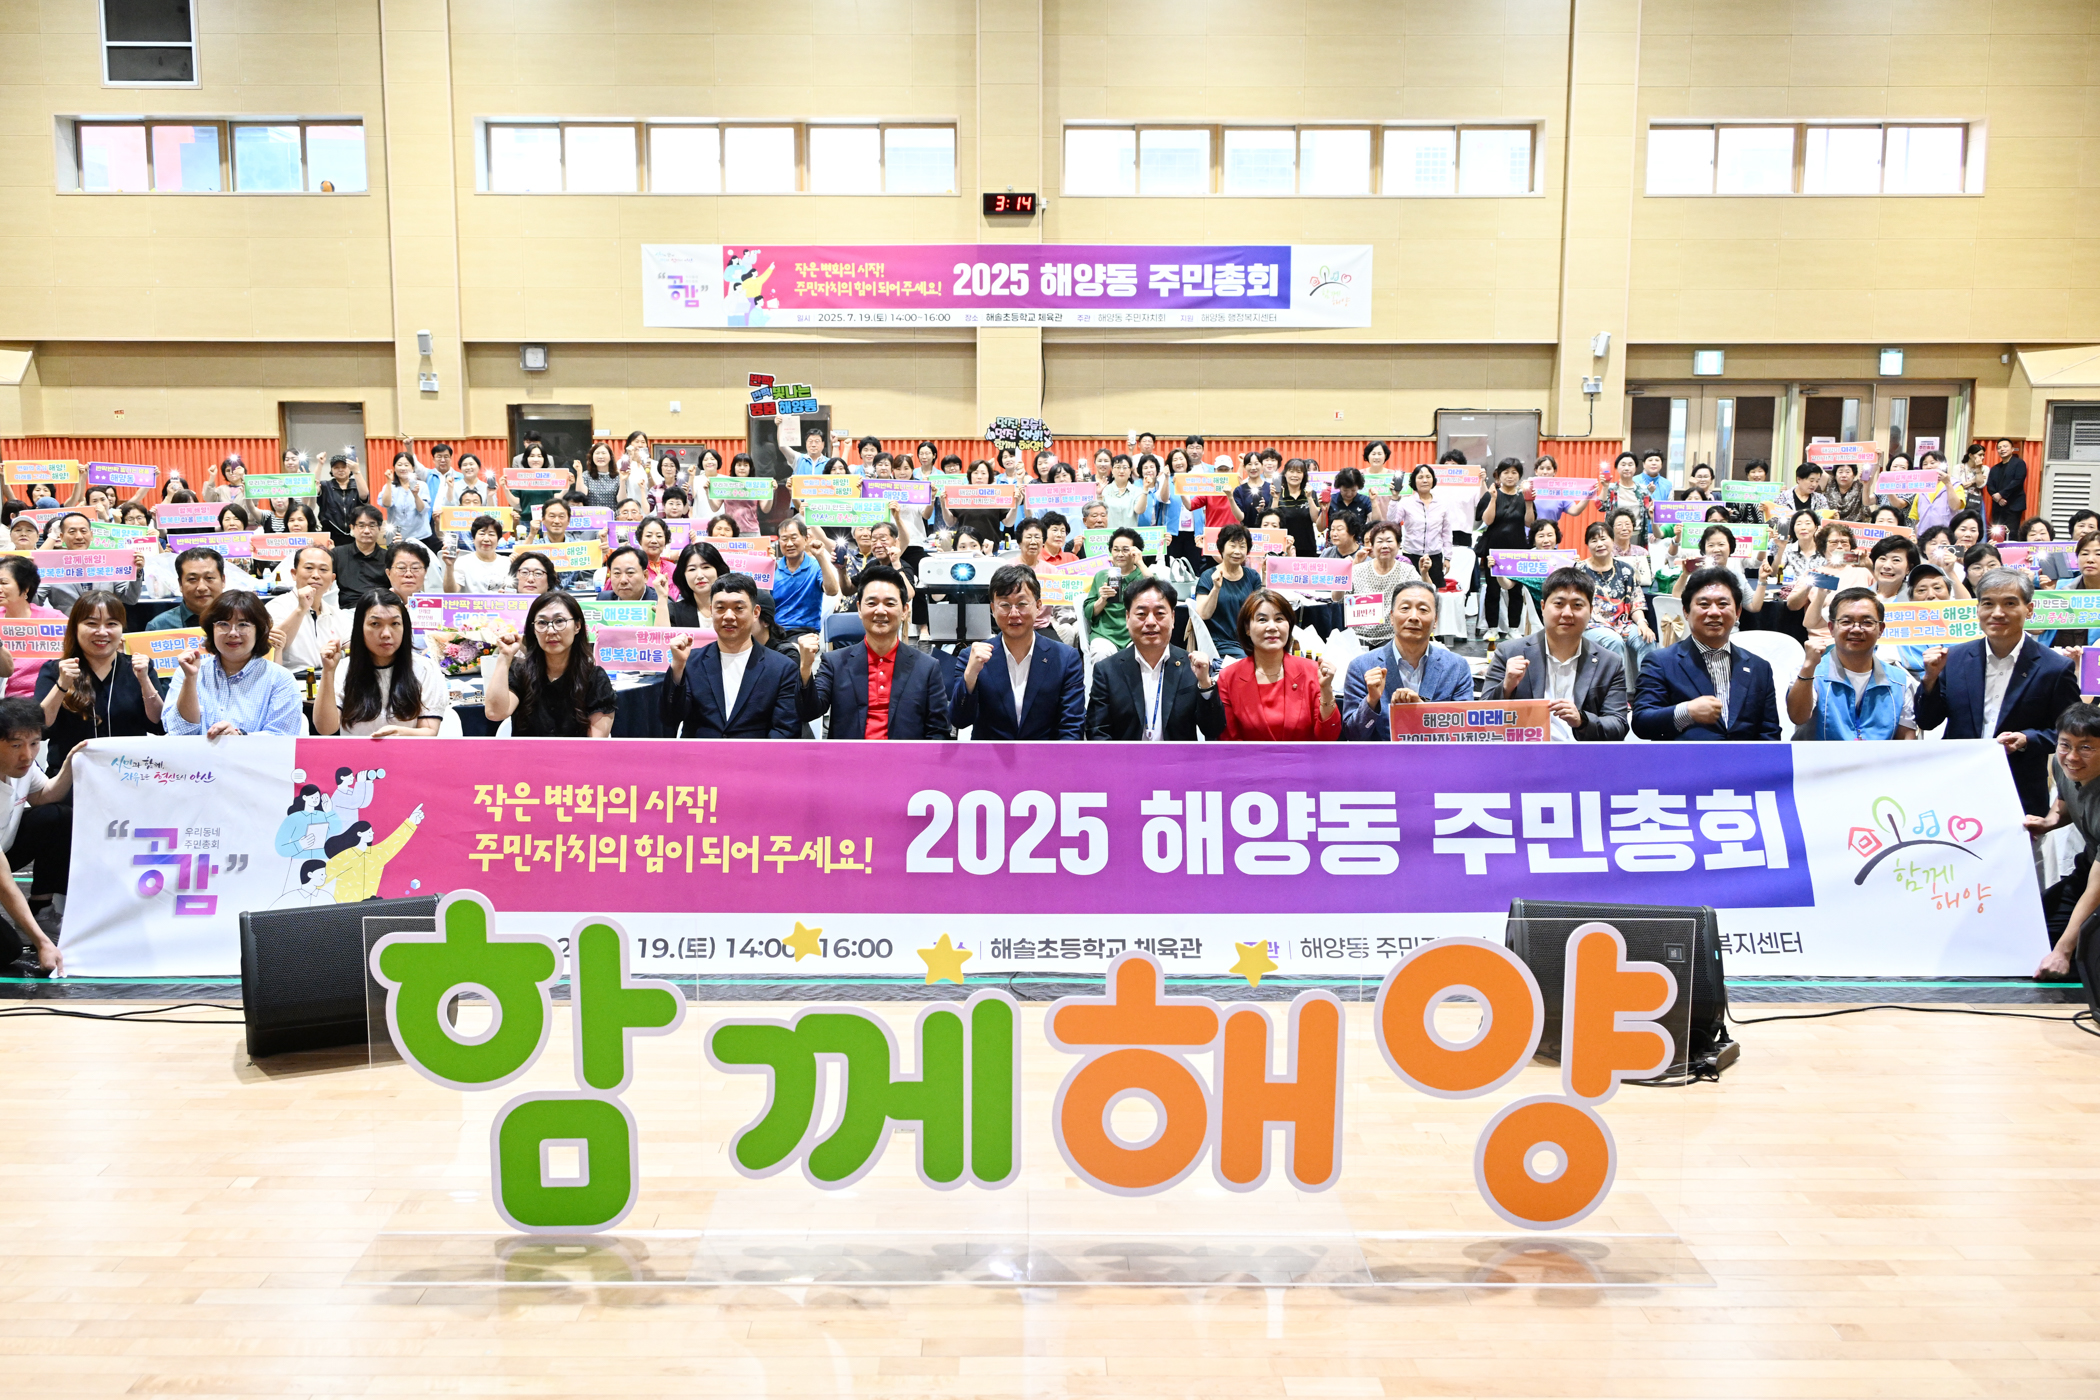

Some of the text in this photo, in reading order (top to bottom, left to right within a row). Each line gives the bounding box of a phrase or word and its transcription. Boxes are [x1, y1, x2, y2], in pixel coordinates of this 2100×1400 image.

[995, 195, 1032, 212] 3:14
[795, 262, 885, 279] 작은 변화의 시작!
[953, 262, 1279, 297] 2025 해양동 주민총회
[795, 280, 942, 297] 주민자치의 힘이 되어 주세요!
[818, 313, 848, 322] 2025.
[985, 313, 1063, 322] 해솔초등학교 체육관
[1098, 313, 1123, 323] 해양동
[1201, 313, 1226, 323] 해양동
[772, 385, 811, 400] 빛나는
[778, 399, 817, 414] 해양동
[110, 473, 134, 483] 해양동
[833, 478, 849, 487] 해양!
[835, 487, 852, 495] 해양!
[883, 491, 909, 501] 해양동
[853, 502, 885, 512] 해양동!
[1675, 510, 1701, 521] 해양동
[567, 546, 586, 556] 해양!
[64, 555, 105, 564] 함께 해양!
[570, 557, 590, 566] 해양!
[116, 566, 132, 574] 해양
[1310, 563, 1327, 572] 해양!
[1517, 561, 1548, 573] 해양동
[754, 573, 769, 582] 해양
[1062, 580, 1082, 589] 해양!
[473, 600, 504, 610] 빛나는
[2043, 599, 2068, 609] 만드는
[604, 607, 648, 621] 해양동!
[1885, 607, 1977, 622] 변화의 중심 해양!
[2047, 613, 2075, 624] 중심을
[2, 626, 38, 637] 해양이
[1914, 626, 1946, 638] 그리는
[1949, 623, 1982, 637] 해양!
[636, 631, 661, 644] 함께
[151, 638, 185, 651] 변화의
[1423, 709, 1518, 728] 해양이 미래다
[111, 755, 141, 773] 시민과
[190, 771, 216, 783] 안산
[473, 782, 719, 824] 작은 변화의 시작!
[185, 827, 220, 837] 우리동네
[905, 789, 1790, 876] 2025 해양동 주민총회
[184, 840, 220, 849] 주민총회
[468, 833, 873, 875] 주민자치의 힘이 되어 주세요!
[1893, 858, 1954, 892] 함께
[1930, 882, 1992, 914] 해양
[990, 937, 1128, 960] 해솔초등학교
[1299, 937, 1370, 960] 해양동
[375, 895, 1671, 1230] 함께 해양
